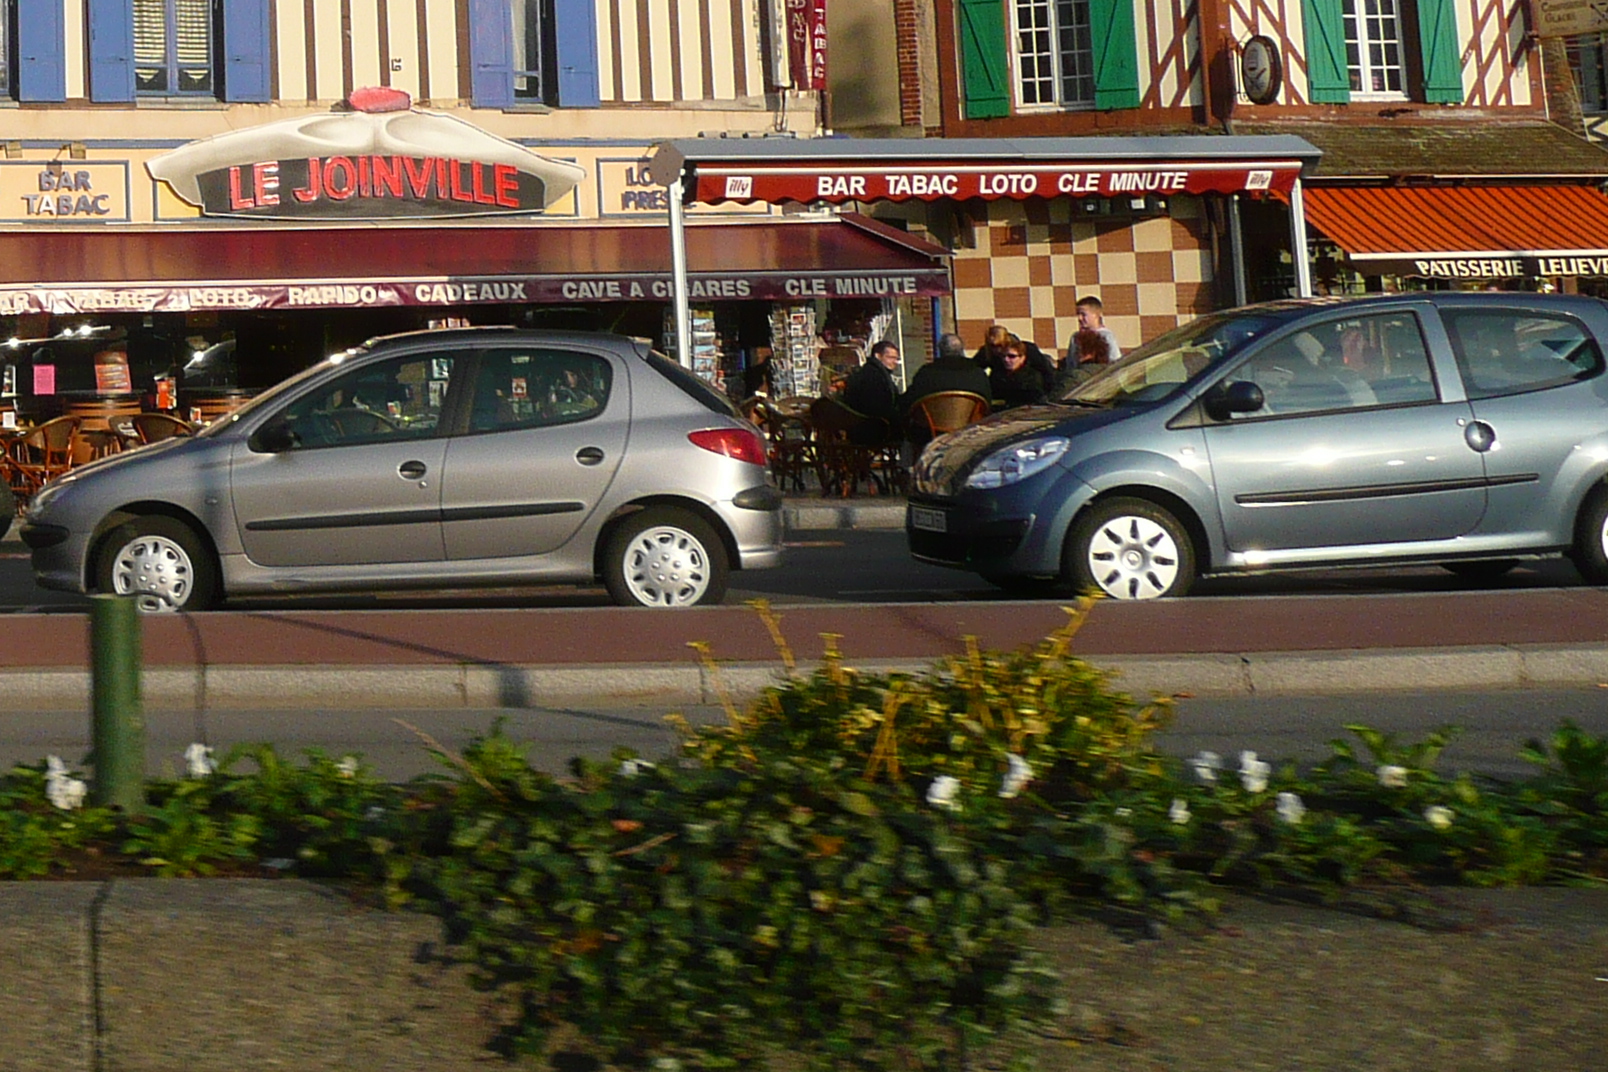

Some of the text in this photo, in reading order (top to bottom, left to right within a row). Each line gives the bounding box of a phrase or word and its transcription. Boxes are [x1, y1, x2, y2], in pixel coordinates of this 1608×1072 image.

[38, 170, 93, 192] BAR
[228, 154, 521, 212] LE JOINVILLE
[728, 177, 750, 196] illy
[817, 175, 866, 197] BAR
[885, 174, 958, 196] TABAC
[978, 172, 1038, 195] LOTO
[1057, 171, 1101, 193] CLE
[1108, 170, 1190, 192] MINUTE
[20, 193, 111, 215] TABAC
[1415, 259, 1525, 277] PATISSERIE
[188, 287, 252, 308] LOTO
[288, 285, 378, 306] RAPIDO
[415, 281, 528, 303] CADEAUX
[562, 280, 623, 300] CAVE
[629, 280, 646, 298] A
[785, 277, 826, 296] CLE
[835, 276, 917, 296] MINUTE
